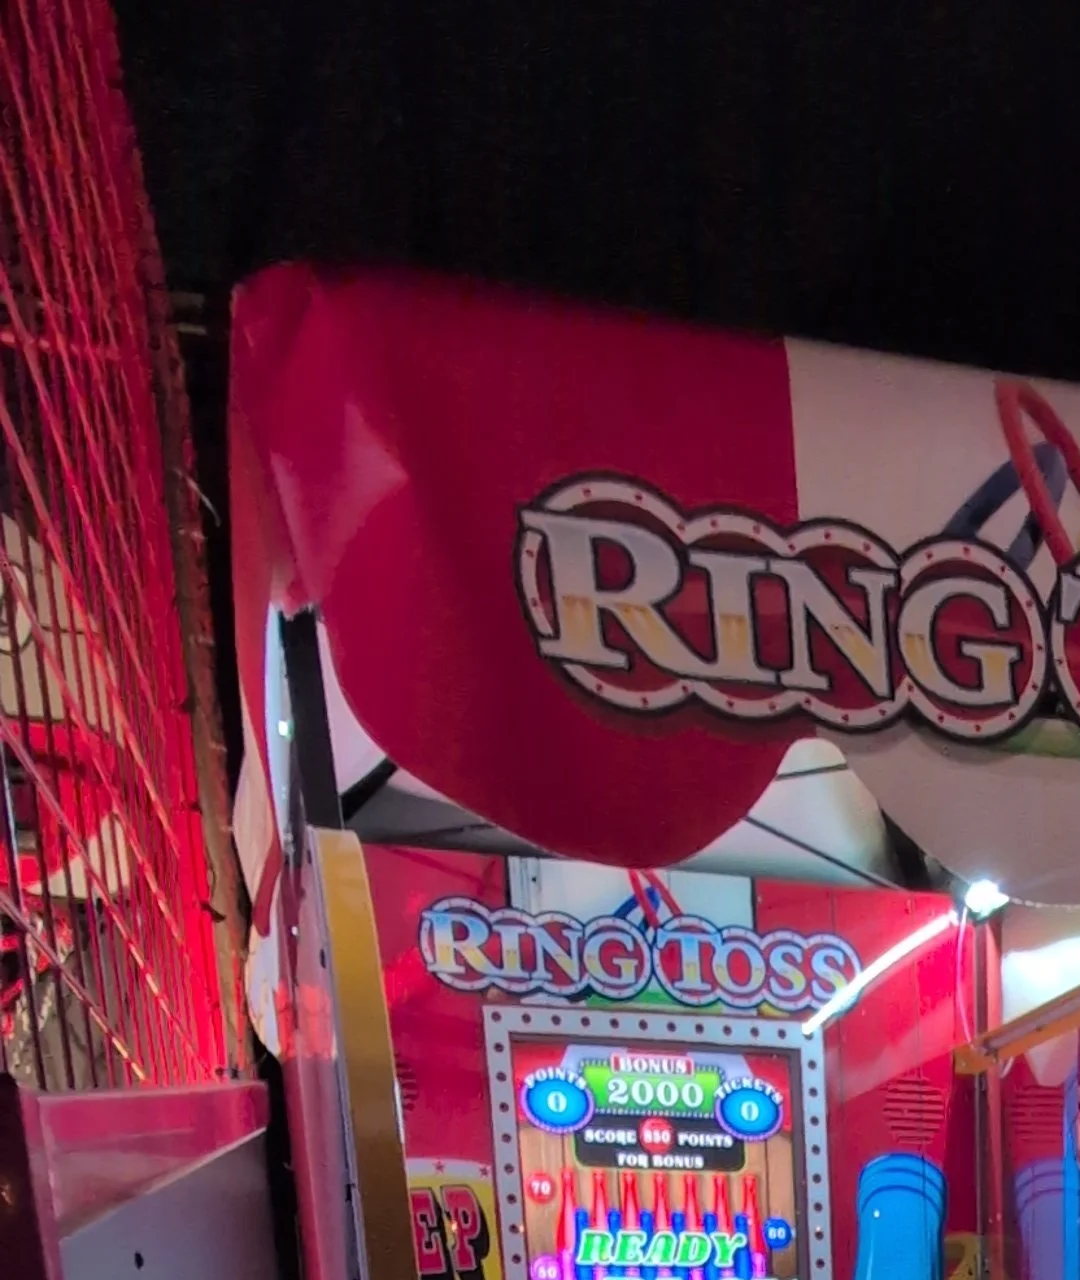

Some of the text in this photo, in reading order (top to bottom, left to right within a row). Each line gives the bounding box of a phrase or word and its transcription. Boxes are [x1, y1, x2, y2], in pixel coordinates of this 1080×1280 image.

[520, 507, 1021, 707] RING
[424, 910, 850, 1001] RING TOSS
[619, 1055, 688, 1074] BONUS
[524, 1067, 588, 1090] POINTS
[547, 1091, 567, 1113] 0
[607, 1078, 704, 1107] 2000
[714, 1076, 784, 1106] TICKETS
[741, 1101, 759, 1122] 0
[584, 1129, 637, 1144] SCORE
[678, 1132, 733, 1148] POINTS
[617, 1153, 704, 1169] FOR BONUS
[532, 1181, 551, 1195] 70
[576, 1231, 747, 1266] READY
